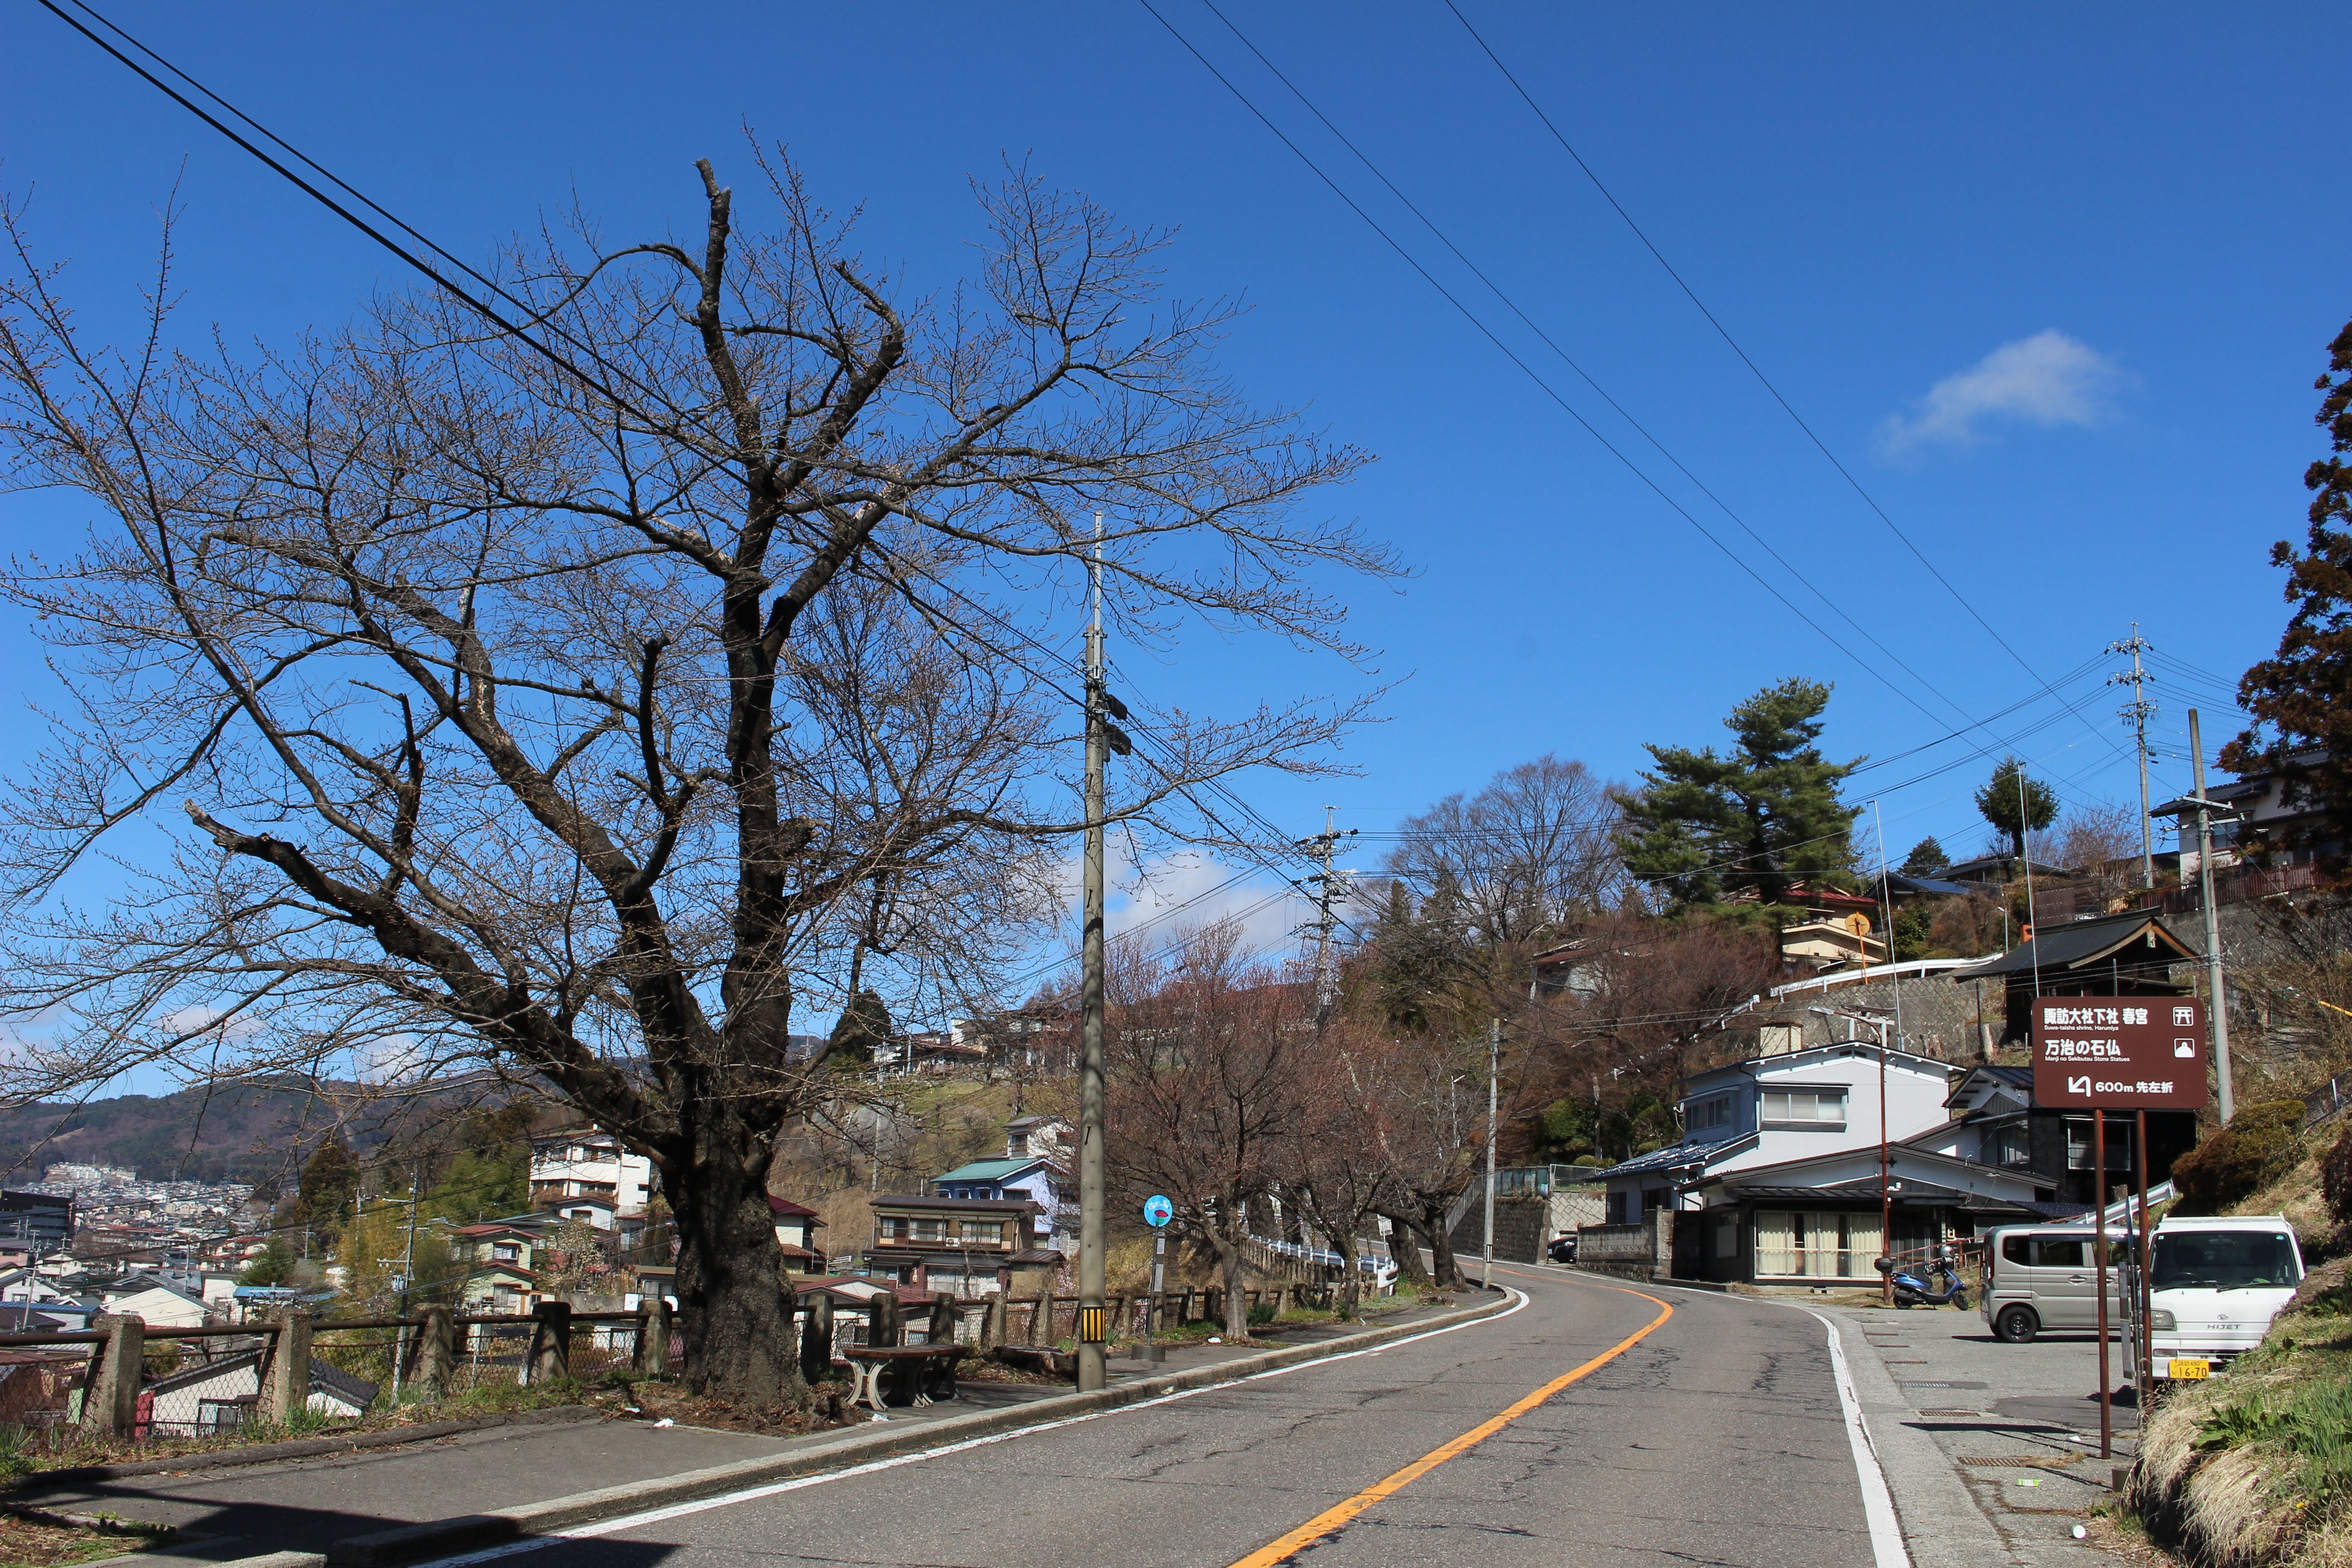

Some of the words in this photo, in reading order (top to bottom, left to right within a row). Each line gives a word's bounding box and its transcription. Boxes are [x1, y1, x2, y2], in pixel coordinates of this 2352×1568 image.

[2044, 1008, 2119, 1024] 諏訪大社下社
[2122, 1008, 2147, 1025] 春宮
[2044, 1039, 2121, 1056] 万治の石仏
[2095, 1082, 2133, 1093] 600m
[2136, 1082, 2173, 1093] 先左折
[2180, 1367, 2207, 1377] 16-70
